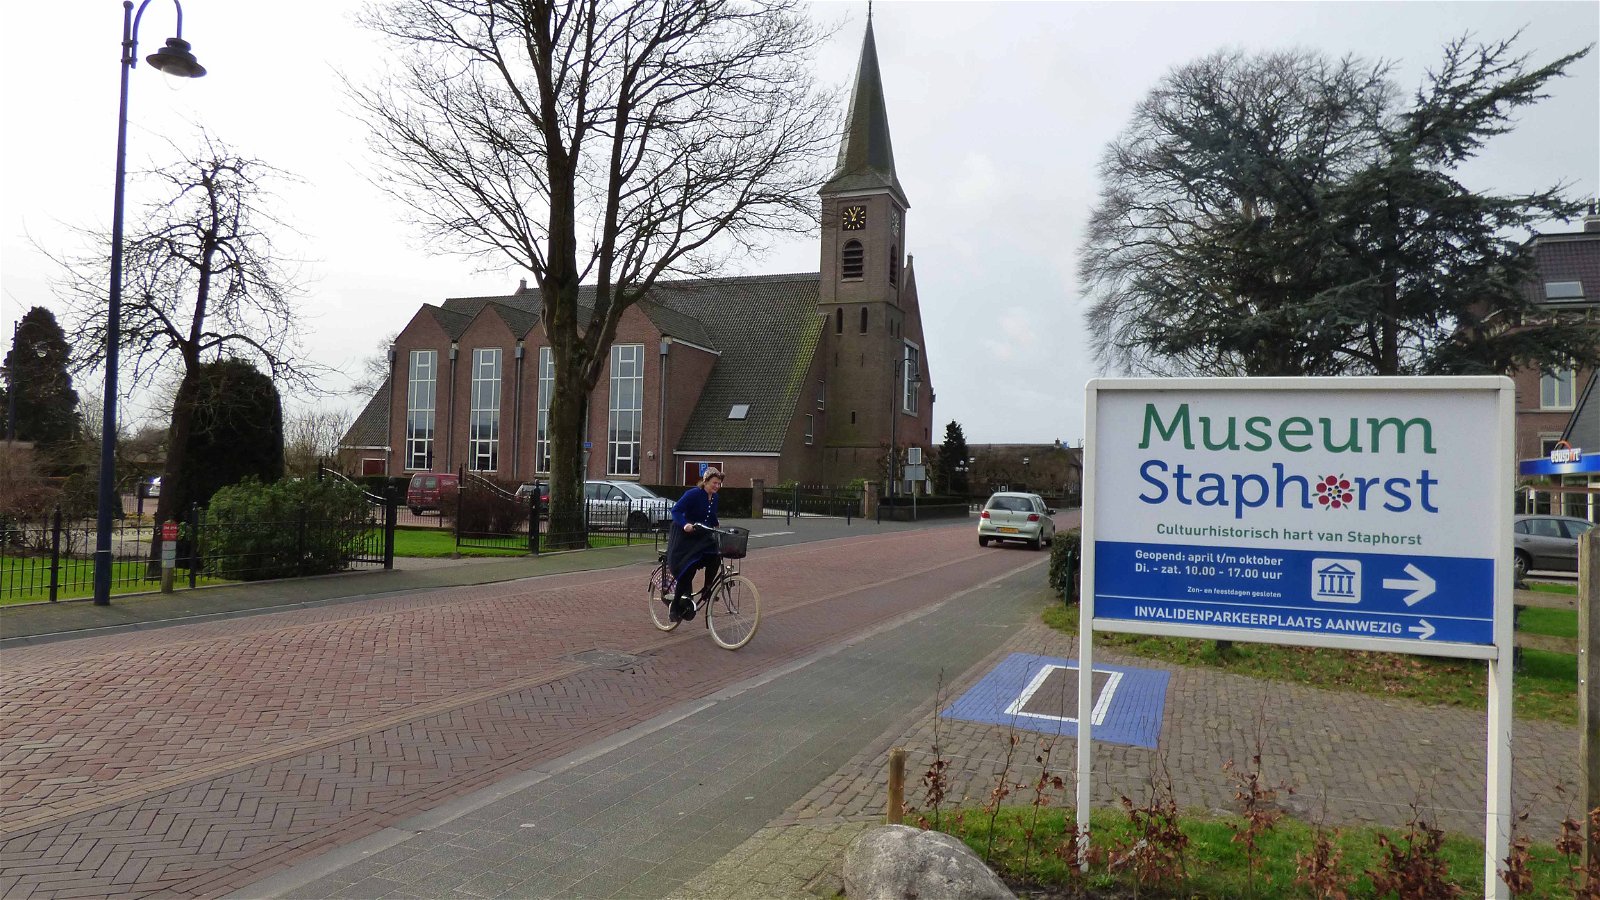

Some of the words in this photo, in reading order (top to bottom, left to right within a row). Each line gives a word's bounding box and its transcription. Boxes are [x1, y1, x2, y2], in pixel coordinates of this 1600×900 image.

[1138, 402, 1437, 454] Museum
[1156, 523, 1279, 540] Cultuurhistorisch
[1283, 528, 1313, 541] hart
[1317, 531, 1343, 543] van
[1347, 531, 1422, 546] Staphorst
[1135, 549, 1186, 562] Geopend:
[1188, 553, 1214, 564] april
[1216, 553, 1236, 564] t/m
[1239, 554, 1284, 566] oktober
[1135, 562, 1150, 573] Di.
[1161, 565, 1182, 574] zat.
[1185, 565, 1216, 576] 10.00
[1228, 567, 1259, 578] 17.00
[1262, 570, 1283, 580] uur
[1187, 586, 1203, 594] Zon-
[1213, 588, 1251, 597] feestdagen
[1251, 590, 1282, 598] gesloten
[1134, 605, 1322, 629] INVALIDENPARKEERPLAATS
[1325, 618, 1402, 635] AANWEZIG
